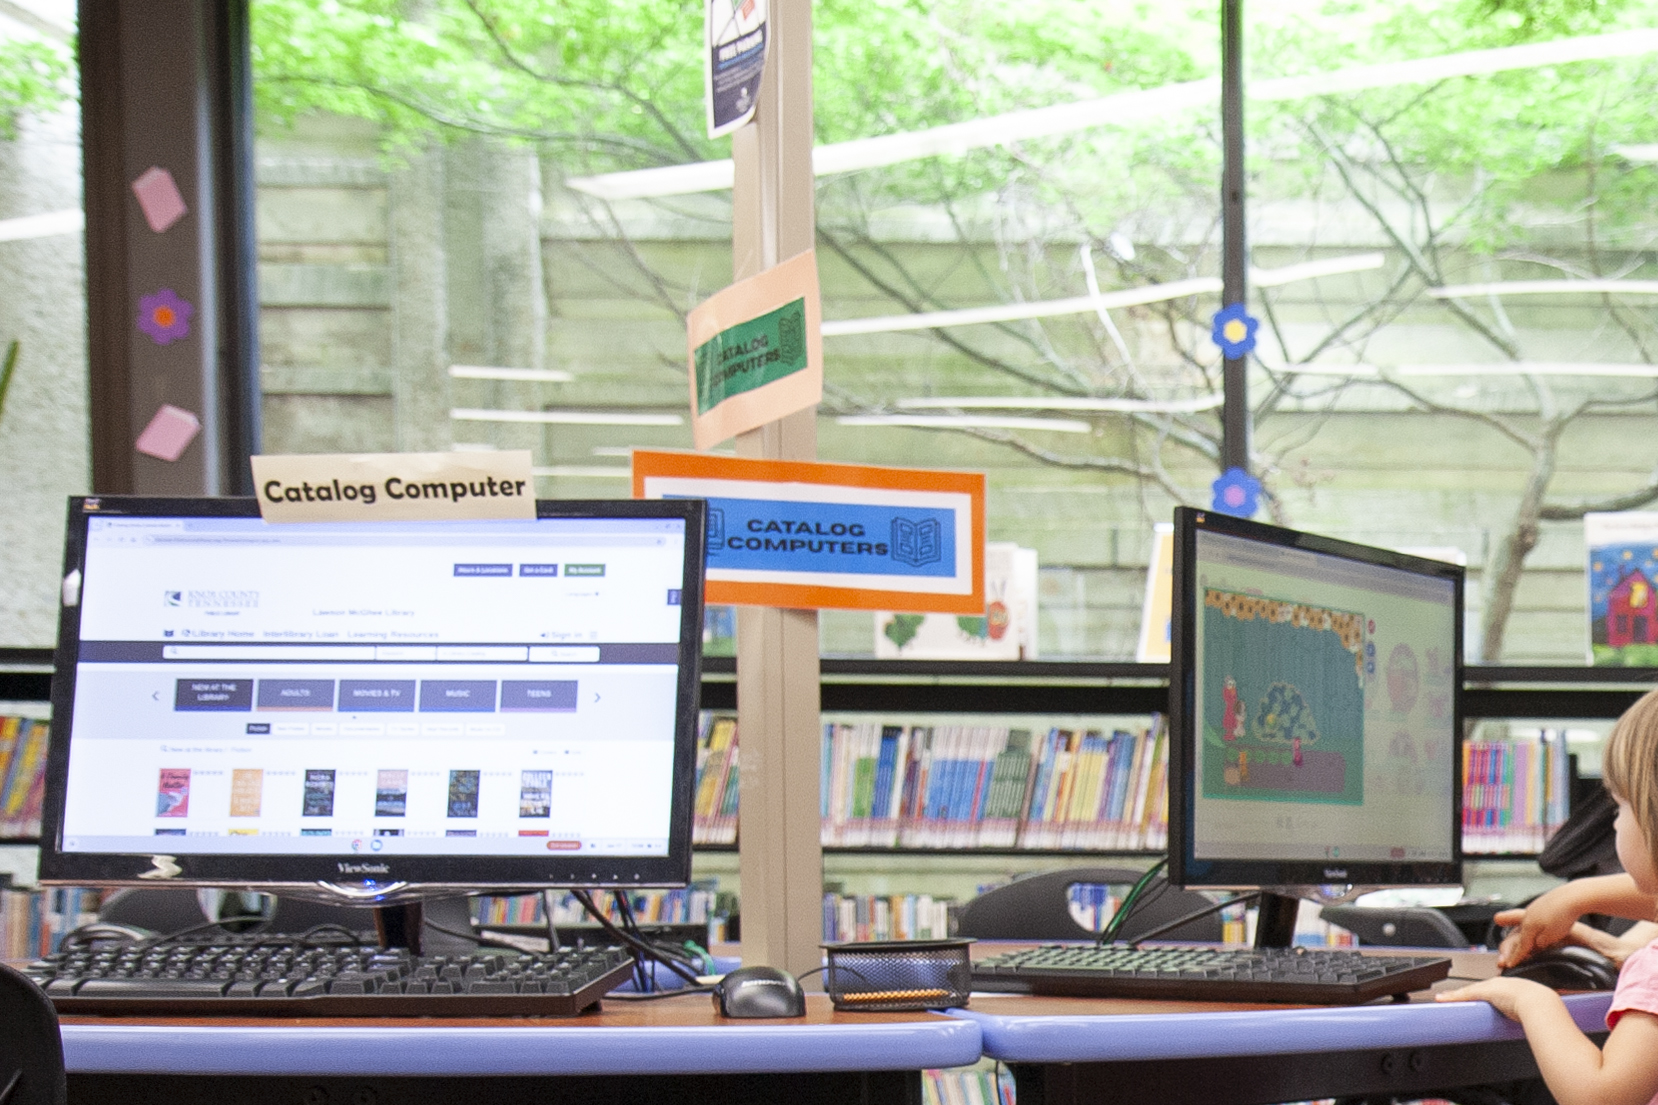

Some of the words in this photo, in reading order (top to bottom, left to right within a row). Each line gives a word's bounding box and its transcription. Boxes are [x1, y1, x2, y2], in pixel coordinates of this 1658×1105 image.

[264, 478, 377, 503] Catalog
[385, 476, 526, 501] Computer
[747, 518, 866, 537] CATALOG
[727, 536, 889, 556] COMPUTERS
